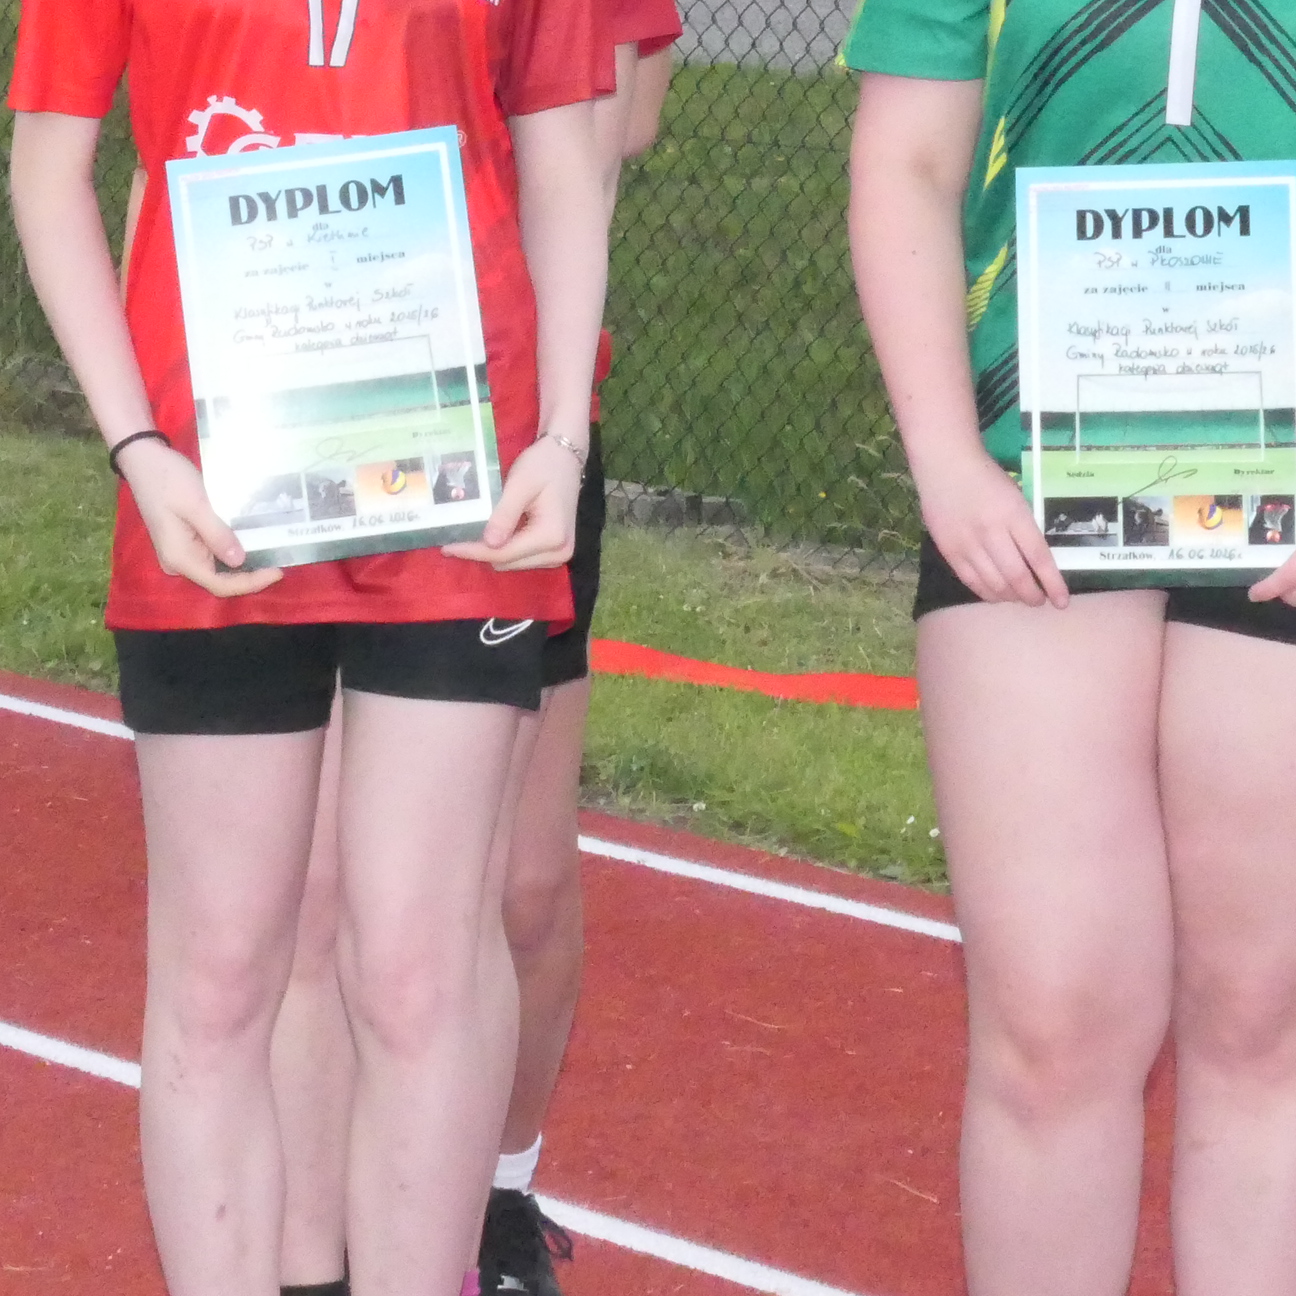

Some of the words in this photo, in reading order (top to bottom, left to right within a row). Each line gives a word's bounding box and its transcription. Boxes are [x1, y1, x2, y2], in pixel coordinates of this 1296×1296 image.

[228, 173, 406, 227] DYPLOM
[1075, 204, 1251, 241] DYPLOM
[1155, 245, 1172, 255] dla
[356, 251, 406, 264] miejsca
[1083, 285, 1099, 294] za
[1102, 283, 1149, 296] zajęcie
[1195, 282, 1246, 293] miejsca
